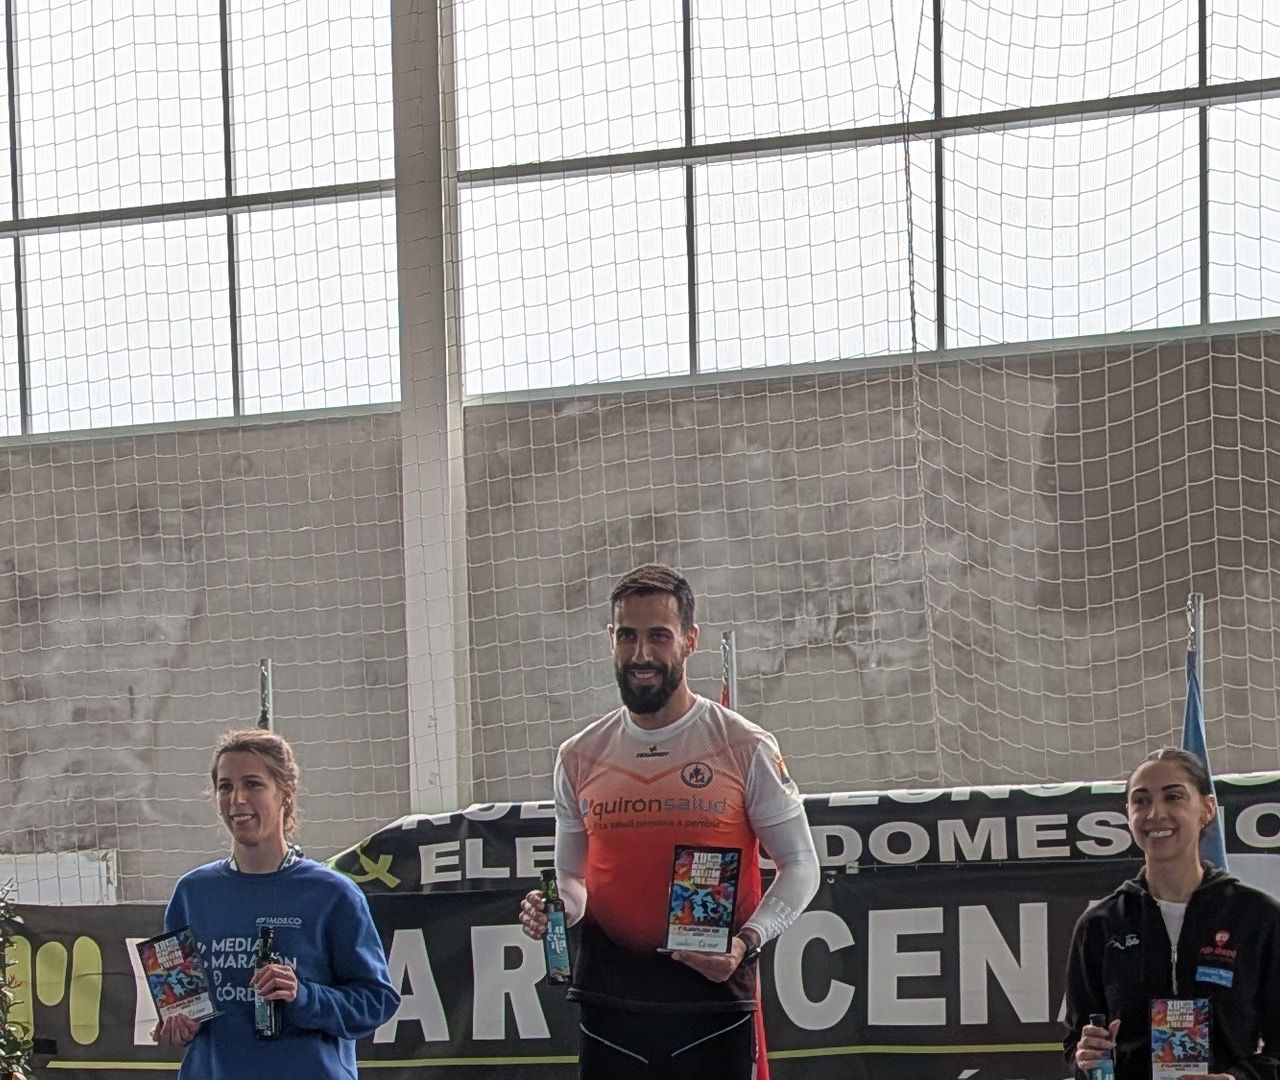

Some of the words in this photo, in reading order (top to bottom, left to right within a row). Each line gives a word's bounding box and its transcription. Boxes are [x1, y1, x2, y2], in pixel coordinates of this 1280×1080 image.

[211, 938, 264, 953] MEDIA
[211, 954, 297, 970] MARAN
[216, 982, 258, 1001] CÓRD
